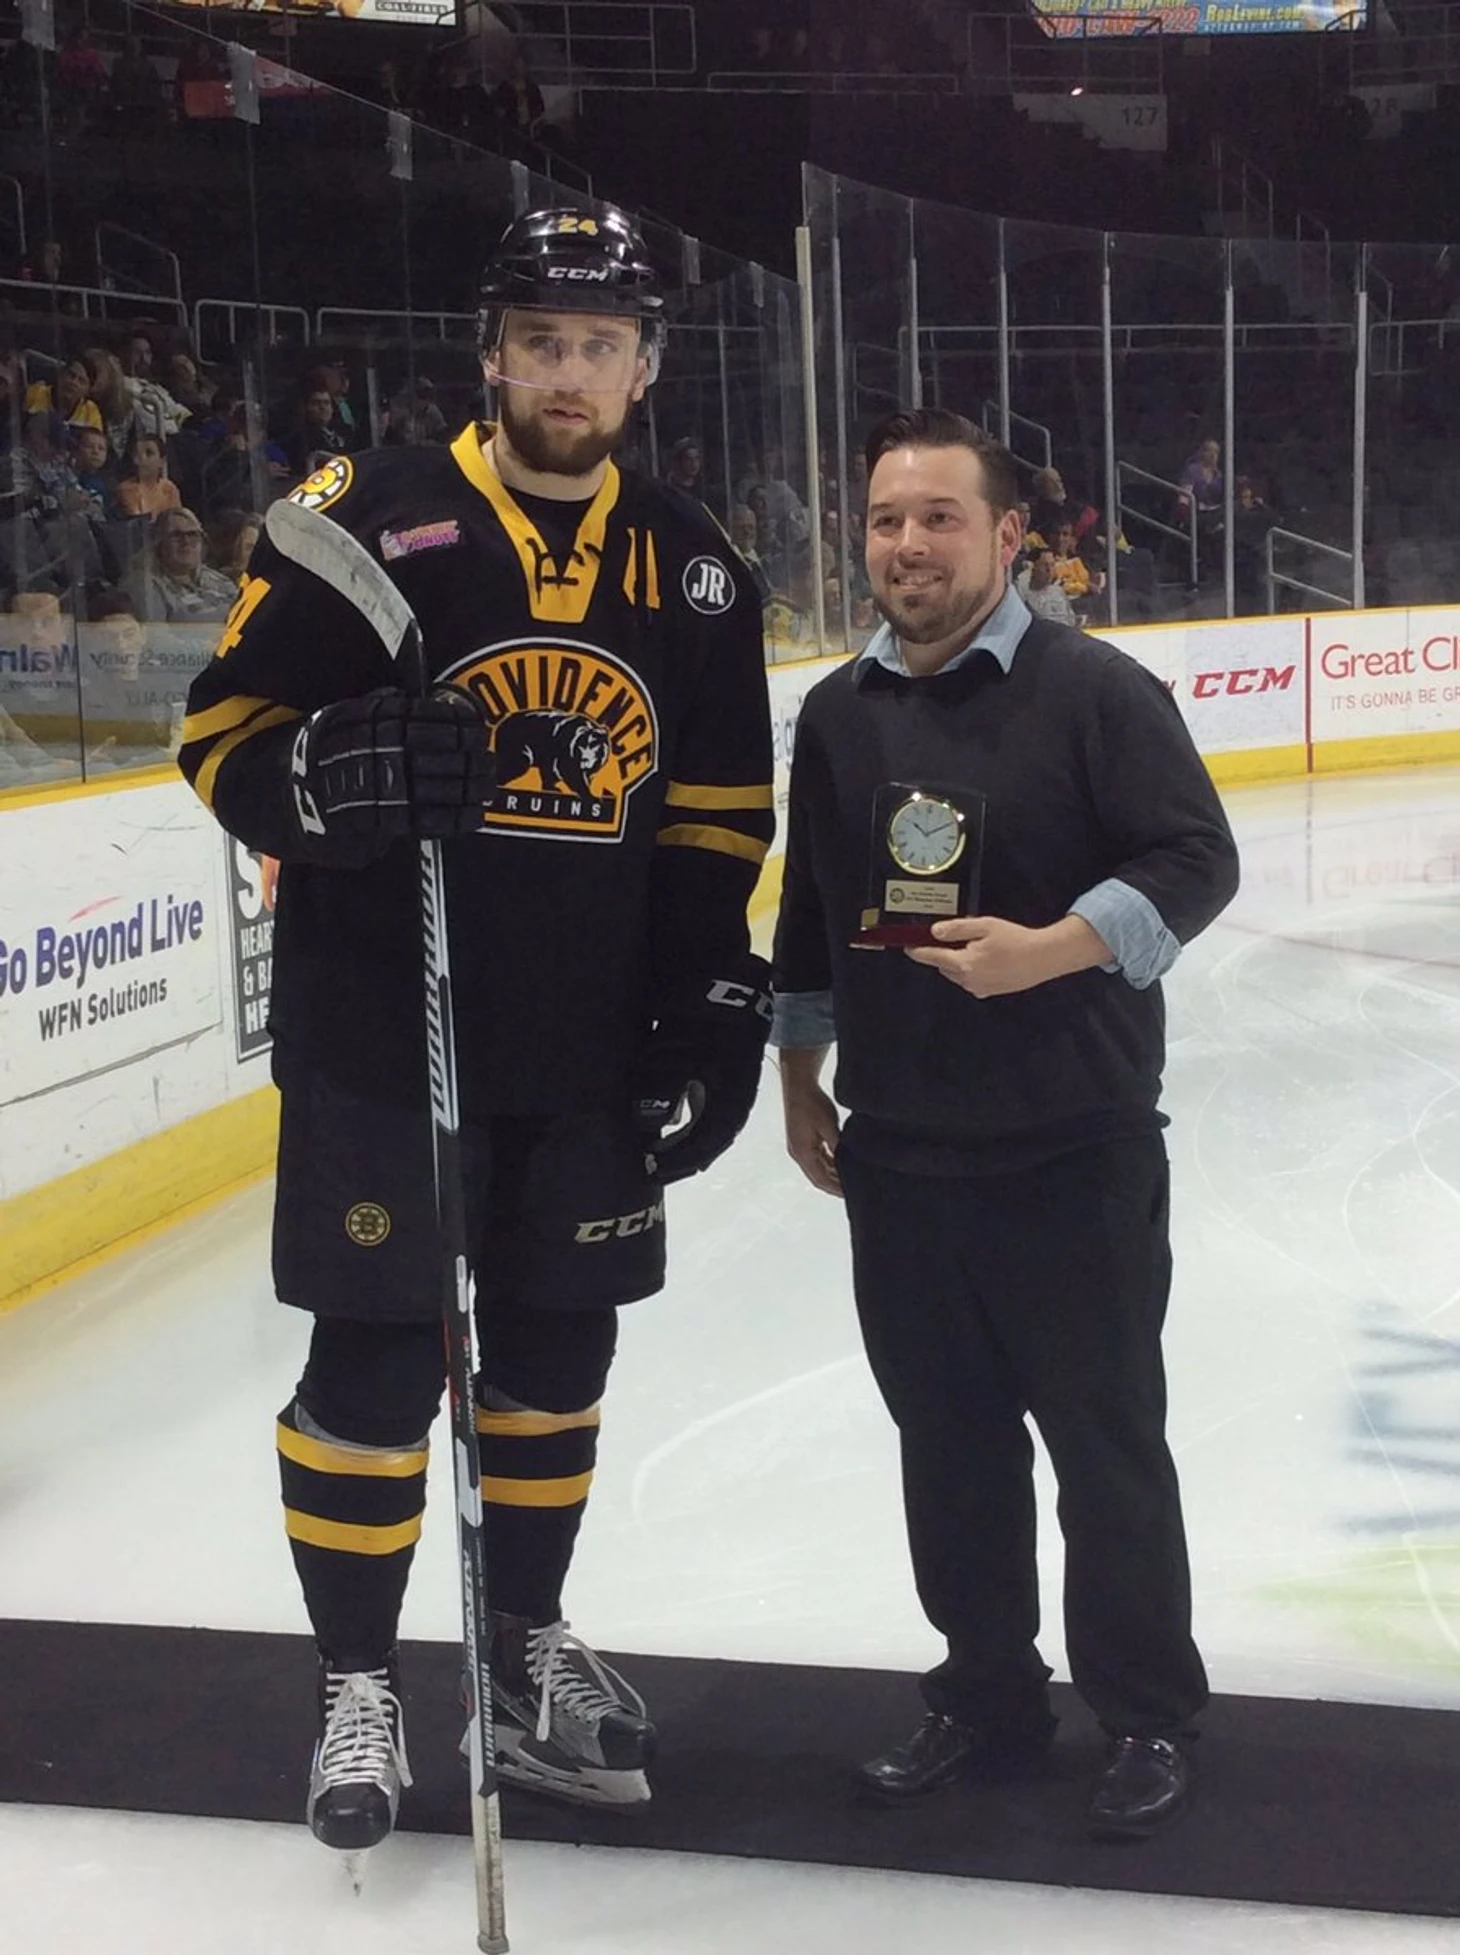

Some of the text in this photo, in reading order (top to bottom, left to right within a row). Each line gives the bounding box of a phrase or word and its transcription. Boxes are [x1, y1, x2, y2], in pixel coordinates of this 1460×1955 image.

[1122, 105, 1157, 127] 127
[558, 216, 598, 236] 24
[547, 267, 609, 282] CCM
[691, 563, 726, 606] JR
[215, 572, 272, 659] 4
[1321, 635, 1460, 679] Great Cl
[1192, 665, 1296, 699] CCM
[1360, 690, 1412, 709] GONNA
[1418, 688, 1437, 703] BE
[467, 656, 652, 780] OVIDENCE
[483, 795, 602, 818] RUINS
[36, 901, 144, 989] Beyond
[150, 894, 204, 953] Live
[240, 918, 275, 960] HEAR
[39, 977, 167, 1042] WFN Solutions
